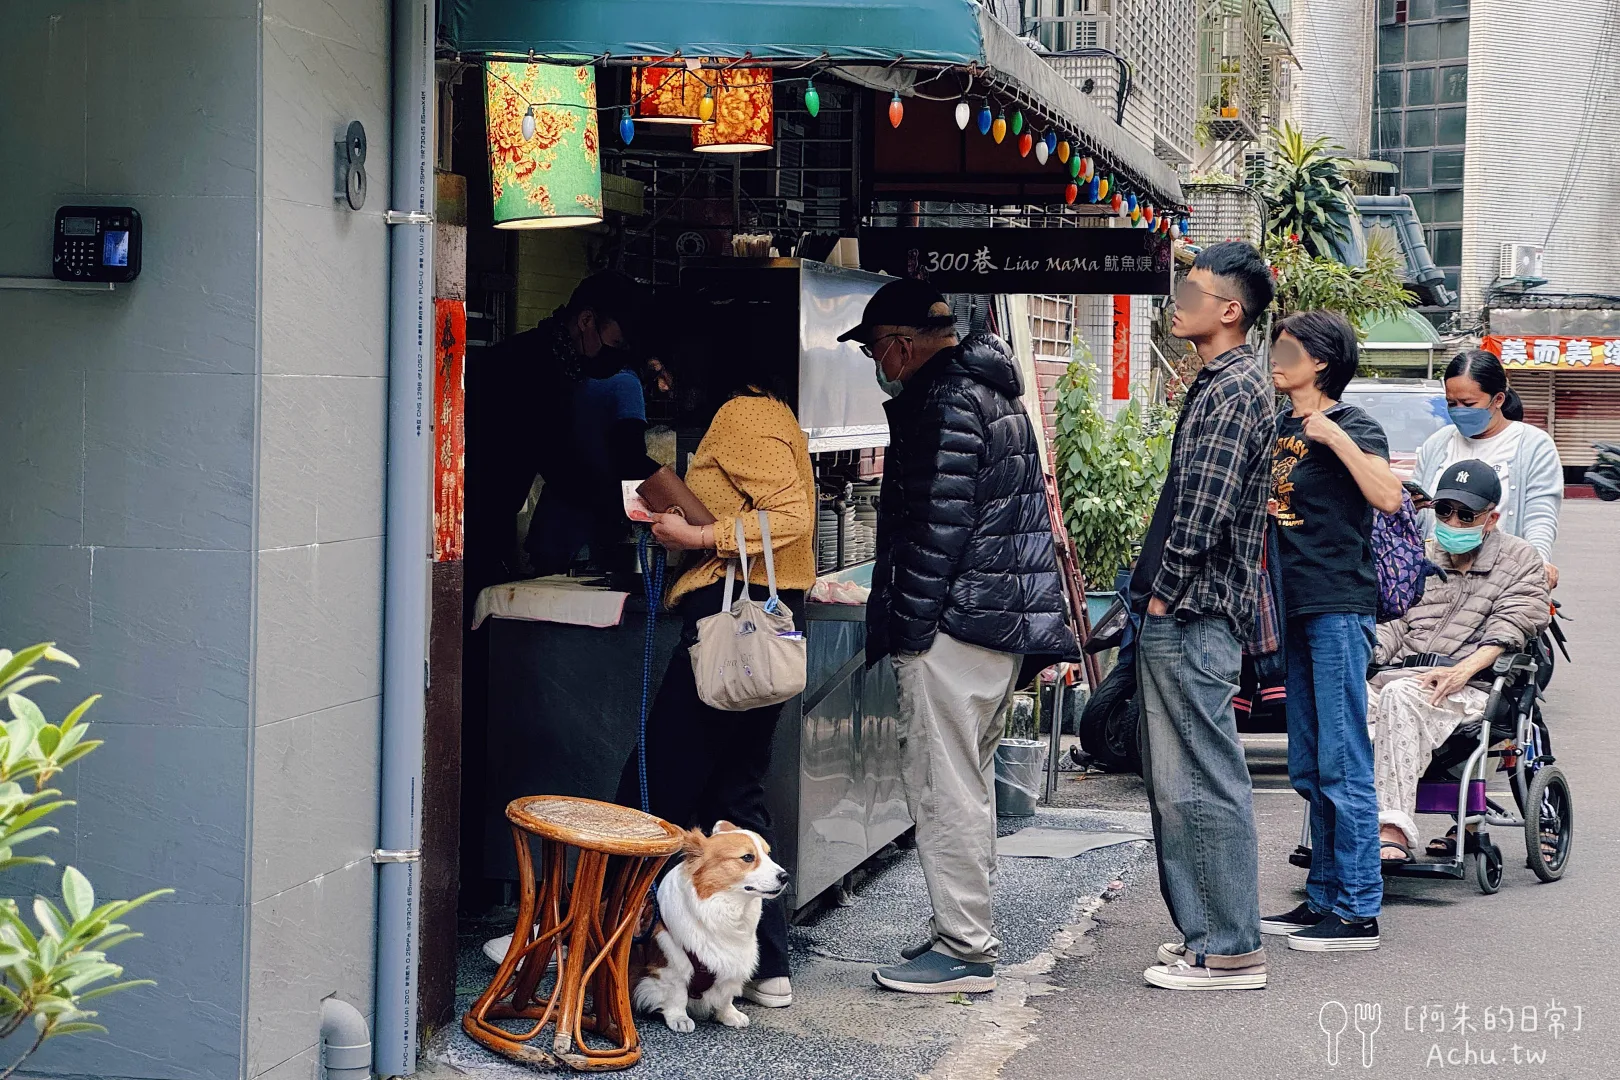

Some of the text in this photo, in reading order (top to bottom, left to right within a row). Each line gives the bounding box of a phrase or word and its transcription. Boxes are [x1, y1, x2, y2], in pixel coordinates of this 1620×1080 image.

[346, 120, 367, 211] 8
[924, 245, 999, 275] 300巷
[1003, 255, 1040, 271] Liao
[1045, 256, 1101, 272] MaMa
[1455, 470, 1470, 484] NY
